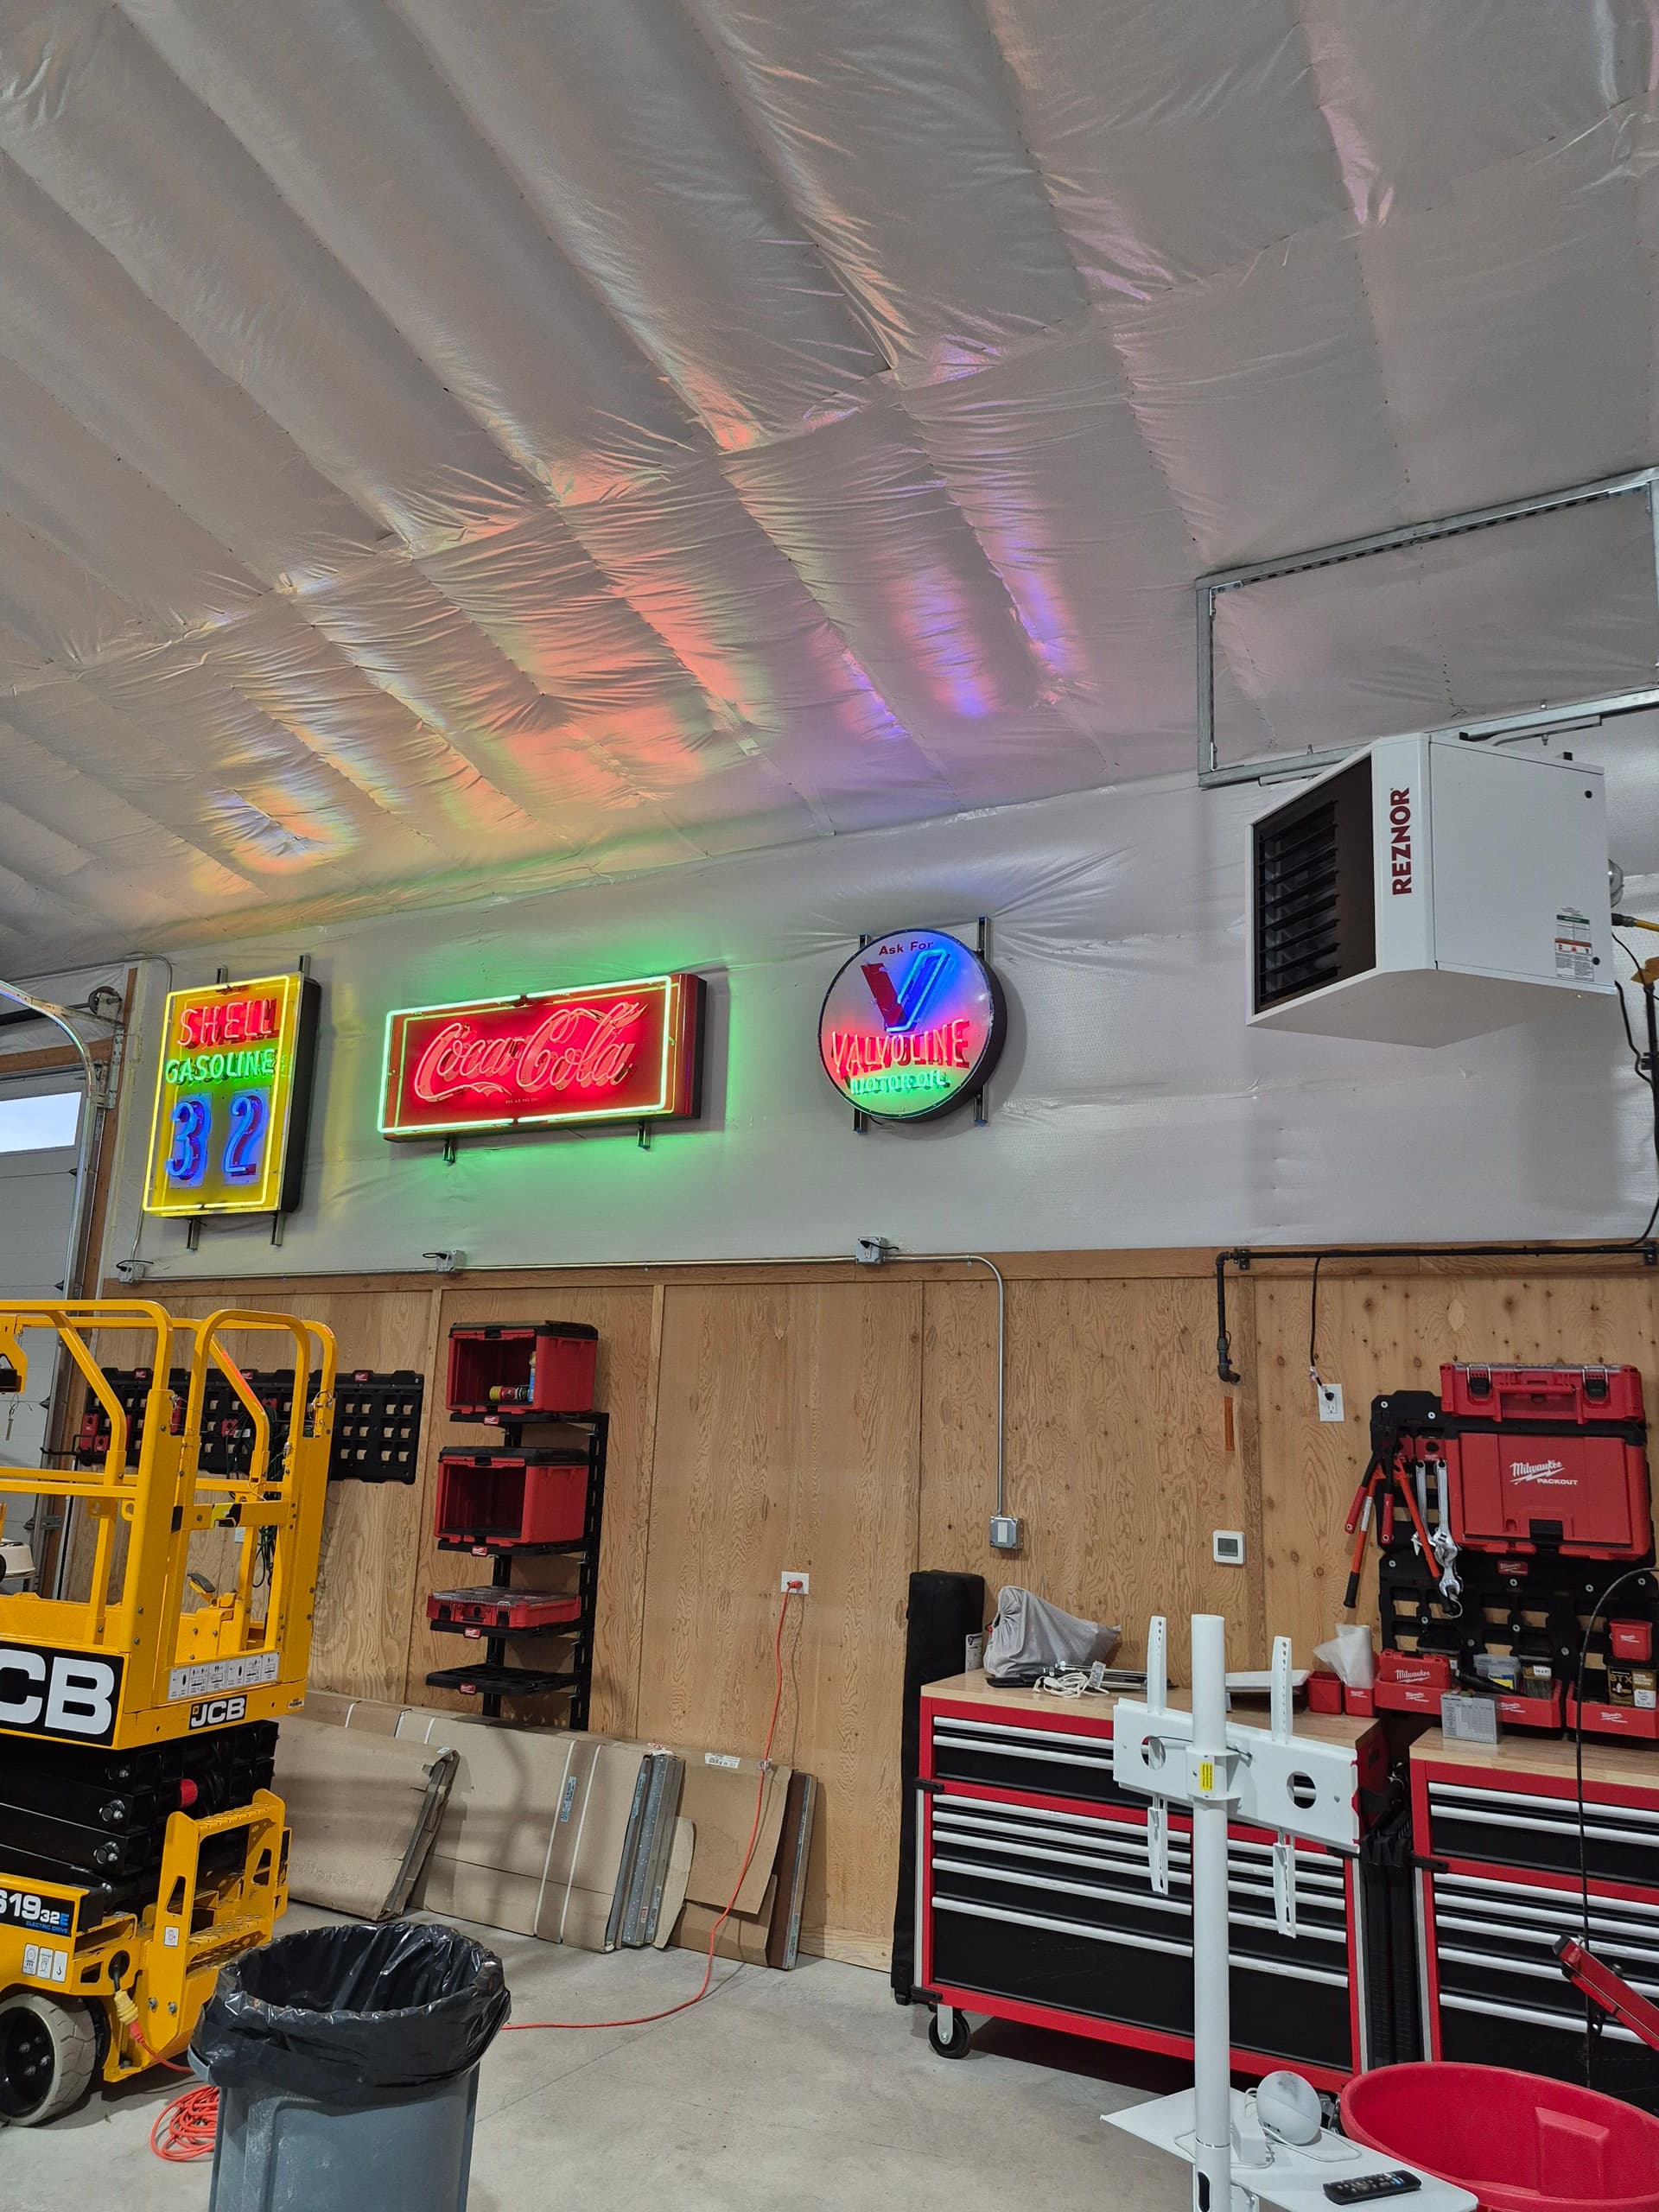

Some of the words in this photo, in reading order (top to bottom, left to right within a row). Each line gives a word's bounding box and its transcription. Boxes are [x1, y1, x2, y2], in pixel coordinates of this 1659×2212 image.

[1389, 787, 1412, 895] REZNOR
[879, 944, 904, 956] Ask
[910, 940, 934, 950] For
[177, 999, 278, 1049] SHELL
[832, 1019, 969, 1076] VALVOLINE
[165, 1048, 277, 1085] GASOLINE
[849, 1073, 912, 1095] MOTOR
[918, 1070, 950, 1090] OIL
[1510, 1459, 1562, 1478] Milwaukee
[1395, 1669, 1431, 1681] Milwaukee
[0, 1649, 115, 1735] CB
[190, 1697, 245, 1727] JCB
[25, 1920, 51, 1931] ELECTRIC
[52, 1925, 68, 1935] DRIVE
